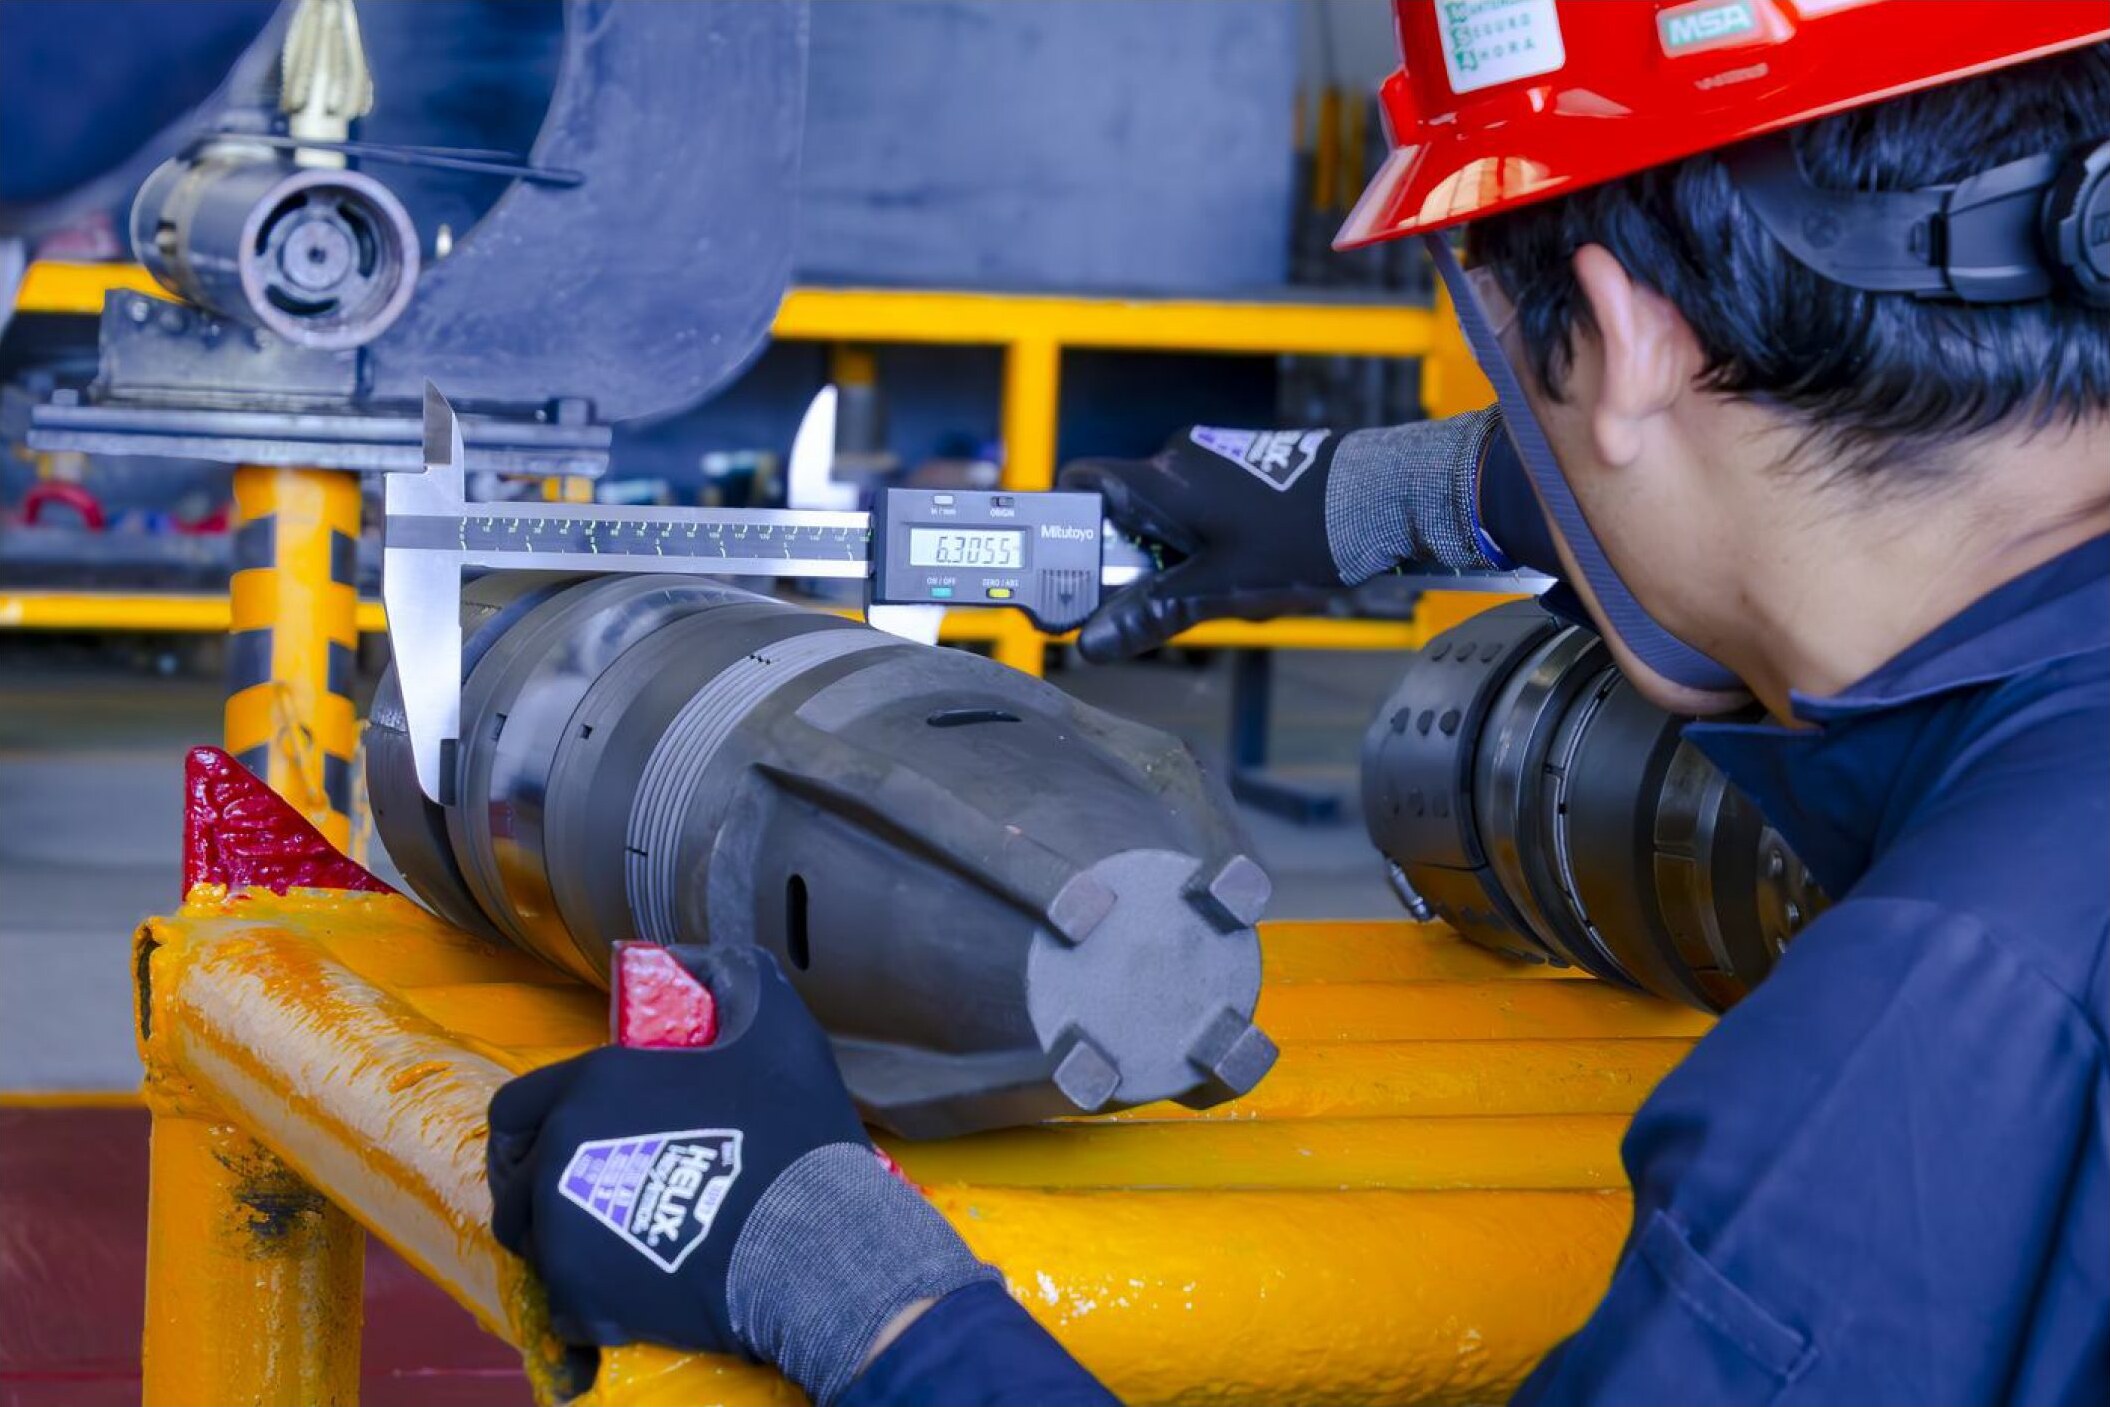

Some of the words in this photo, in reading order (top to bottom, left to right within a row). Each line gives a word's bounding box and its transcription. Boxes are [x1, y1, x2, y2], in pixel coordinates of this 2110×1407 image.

[1668, 4, 1752, 46] MSA
[1040, 524, 1094, 542] Mitutoyo
[935, 536, 1012, 565] 6.3055
